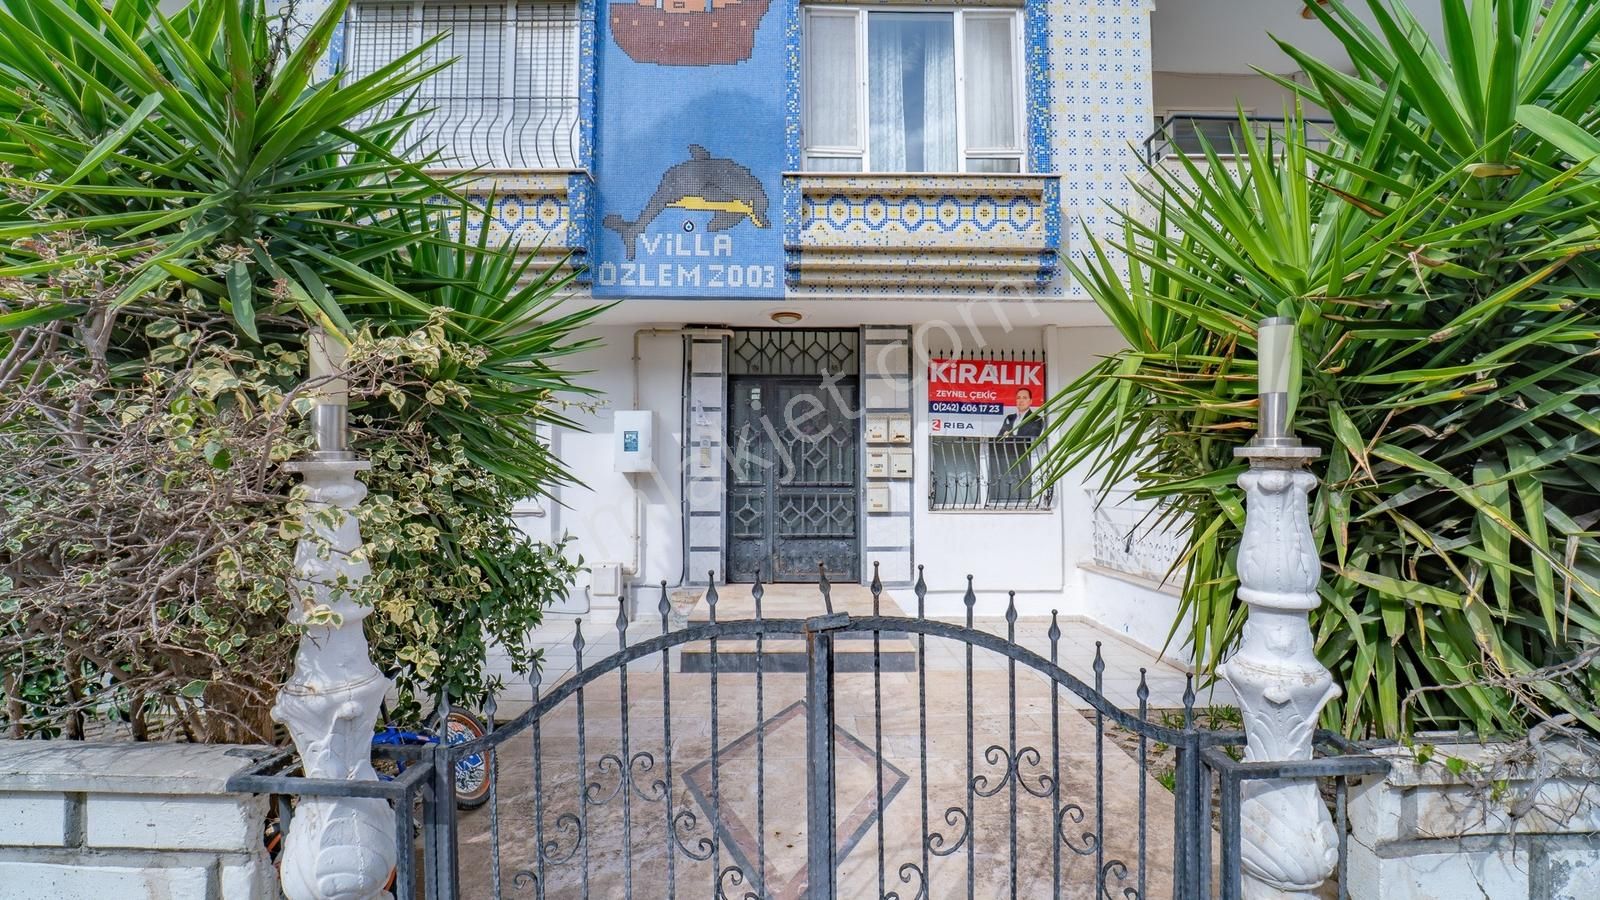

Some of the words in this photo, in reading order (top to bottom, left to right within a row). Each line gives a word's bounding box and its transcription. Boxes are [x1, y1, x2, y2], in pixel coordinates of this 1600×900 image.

[599, 261, 700, 286] ÖZLEM
[936, 389, 968, 399] ZEYNEL
[932, 402, 959, 413] 0(242)
[961, 403, 978, 413] 606
[979, 404, 987, 412] 17
[988, 405, 1000, 413] 23
[943, 421, 974, 430] RIBA
